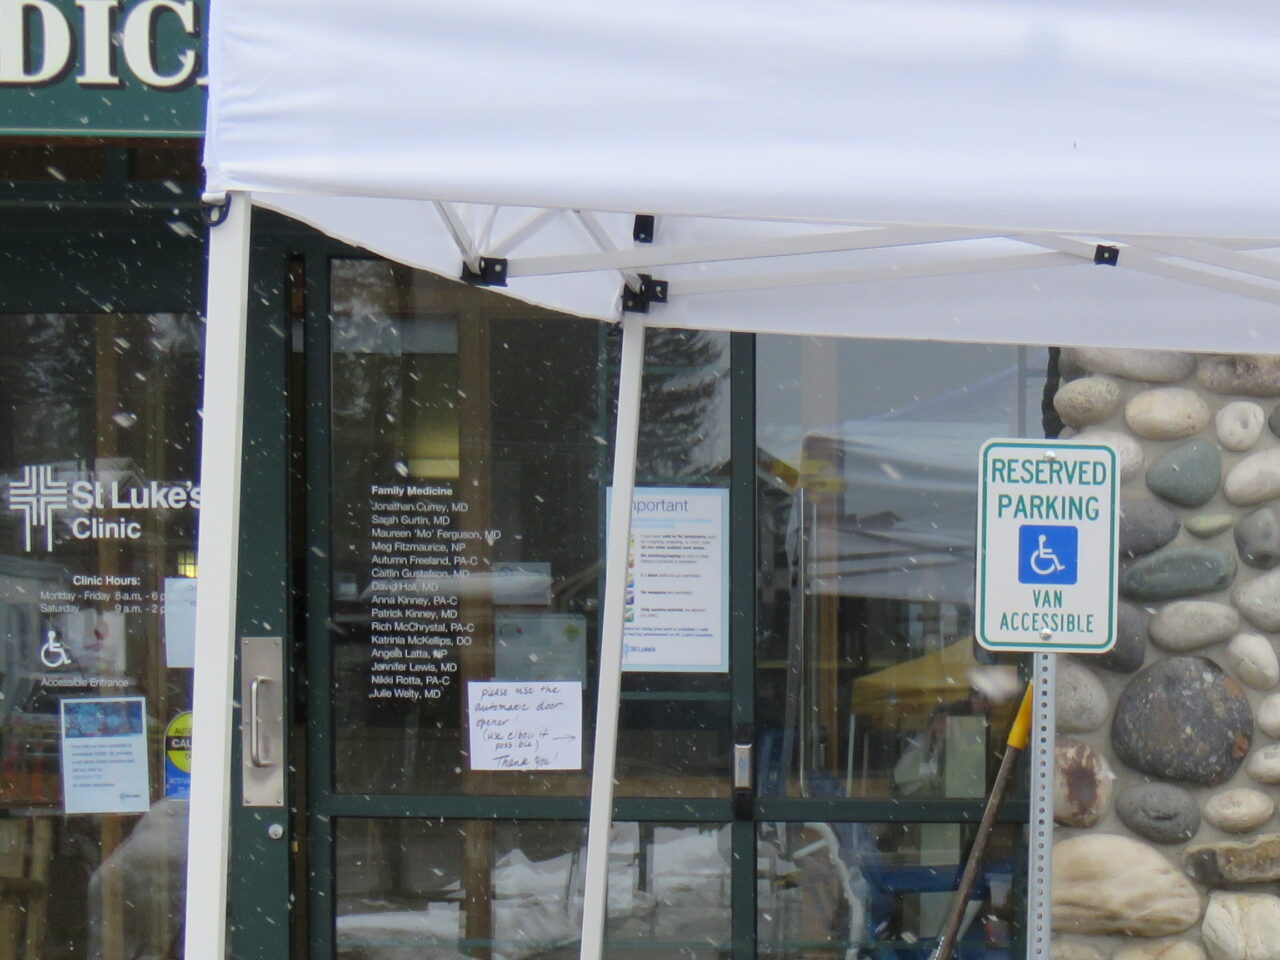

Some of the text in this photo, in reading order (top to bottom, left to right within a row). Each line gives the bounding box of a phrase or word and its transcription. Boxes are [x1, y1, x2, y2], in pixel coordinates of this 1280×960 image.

[0, 0, 209, 87] DIC
[991, 458, 1107, 486] RESERVED
[72, 481, 201, 510] St Luke's
[371, 485, 453, 496] Family Medicine
[371, 502, 414, 511] Jonathan
[452, 503, 468, 512] MD
[632, 499, 689, 514] portant
[998, 494, 1099, 521] PARKING
[433, 516, 450, 525] MD
[72, 517, 142, 540] Clinic
[371, 528, 411, 538] Maureen
[437, 530, 482, 541] Ferguson,
[485, 530, 502, 540] MD
[371, 542, 466, 553] Meg Fitzmaurice, NP
[371, 555, 478, 566] Autumn Freeland, PA-C
[371, 568, 400, 578] Caitlin
[453, 570, 470, 578] MD
[73, 575, 141, 586] Clinic Hours:
[371, 582, 438, 592] David Hall, MD
[40, 591, 76, 601] Monday
[84, 591, 111, 601] Friday
[151, 591, 158, 600] 6
[371, 595, 458, 607] Anna Kinney, PA-C
[1032, 589, 1063, 609] VAN
[40, 604, 80, 614] Saturday
[151, 604, 158, 613] 2
[371, 608, 458, 620] Patrick Kinney, MD
[371, 621, 475, 633] Rich McChrystal, PA-C
[1000, 612, 1094, 634] ACCESSIBLE
[407, 635, 454, 647] McKellips,
[456, 636, 472, 646] DO
[371, 648, 403, 659] Angela
[405, 649, 431, 659] Latta,
[371, 662, 457, 673] Jennifer Lewis, MD
[40, 677, 129, 687] Accessible Entrance
[371, 675, 450, 686] Nikki Rotta, PA-C
[371, 689, 441, 700] Julie Welty, MD
